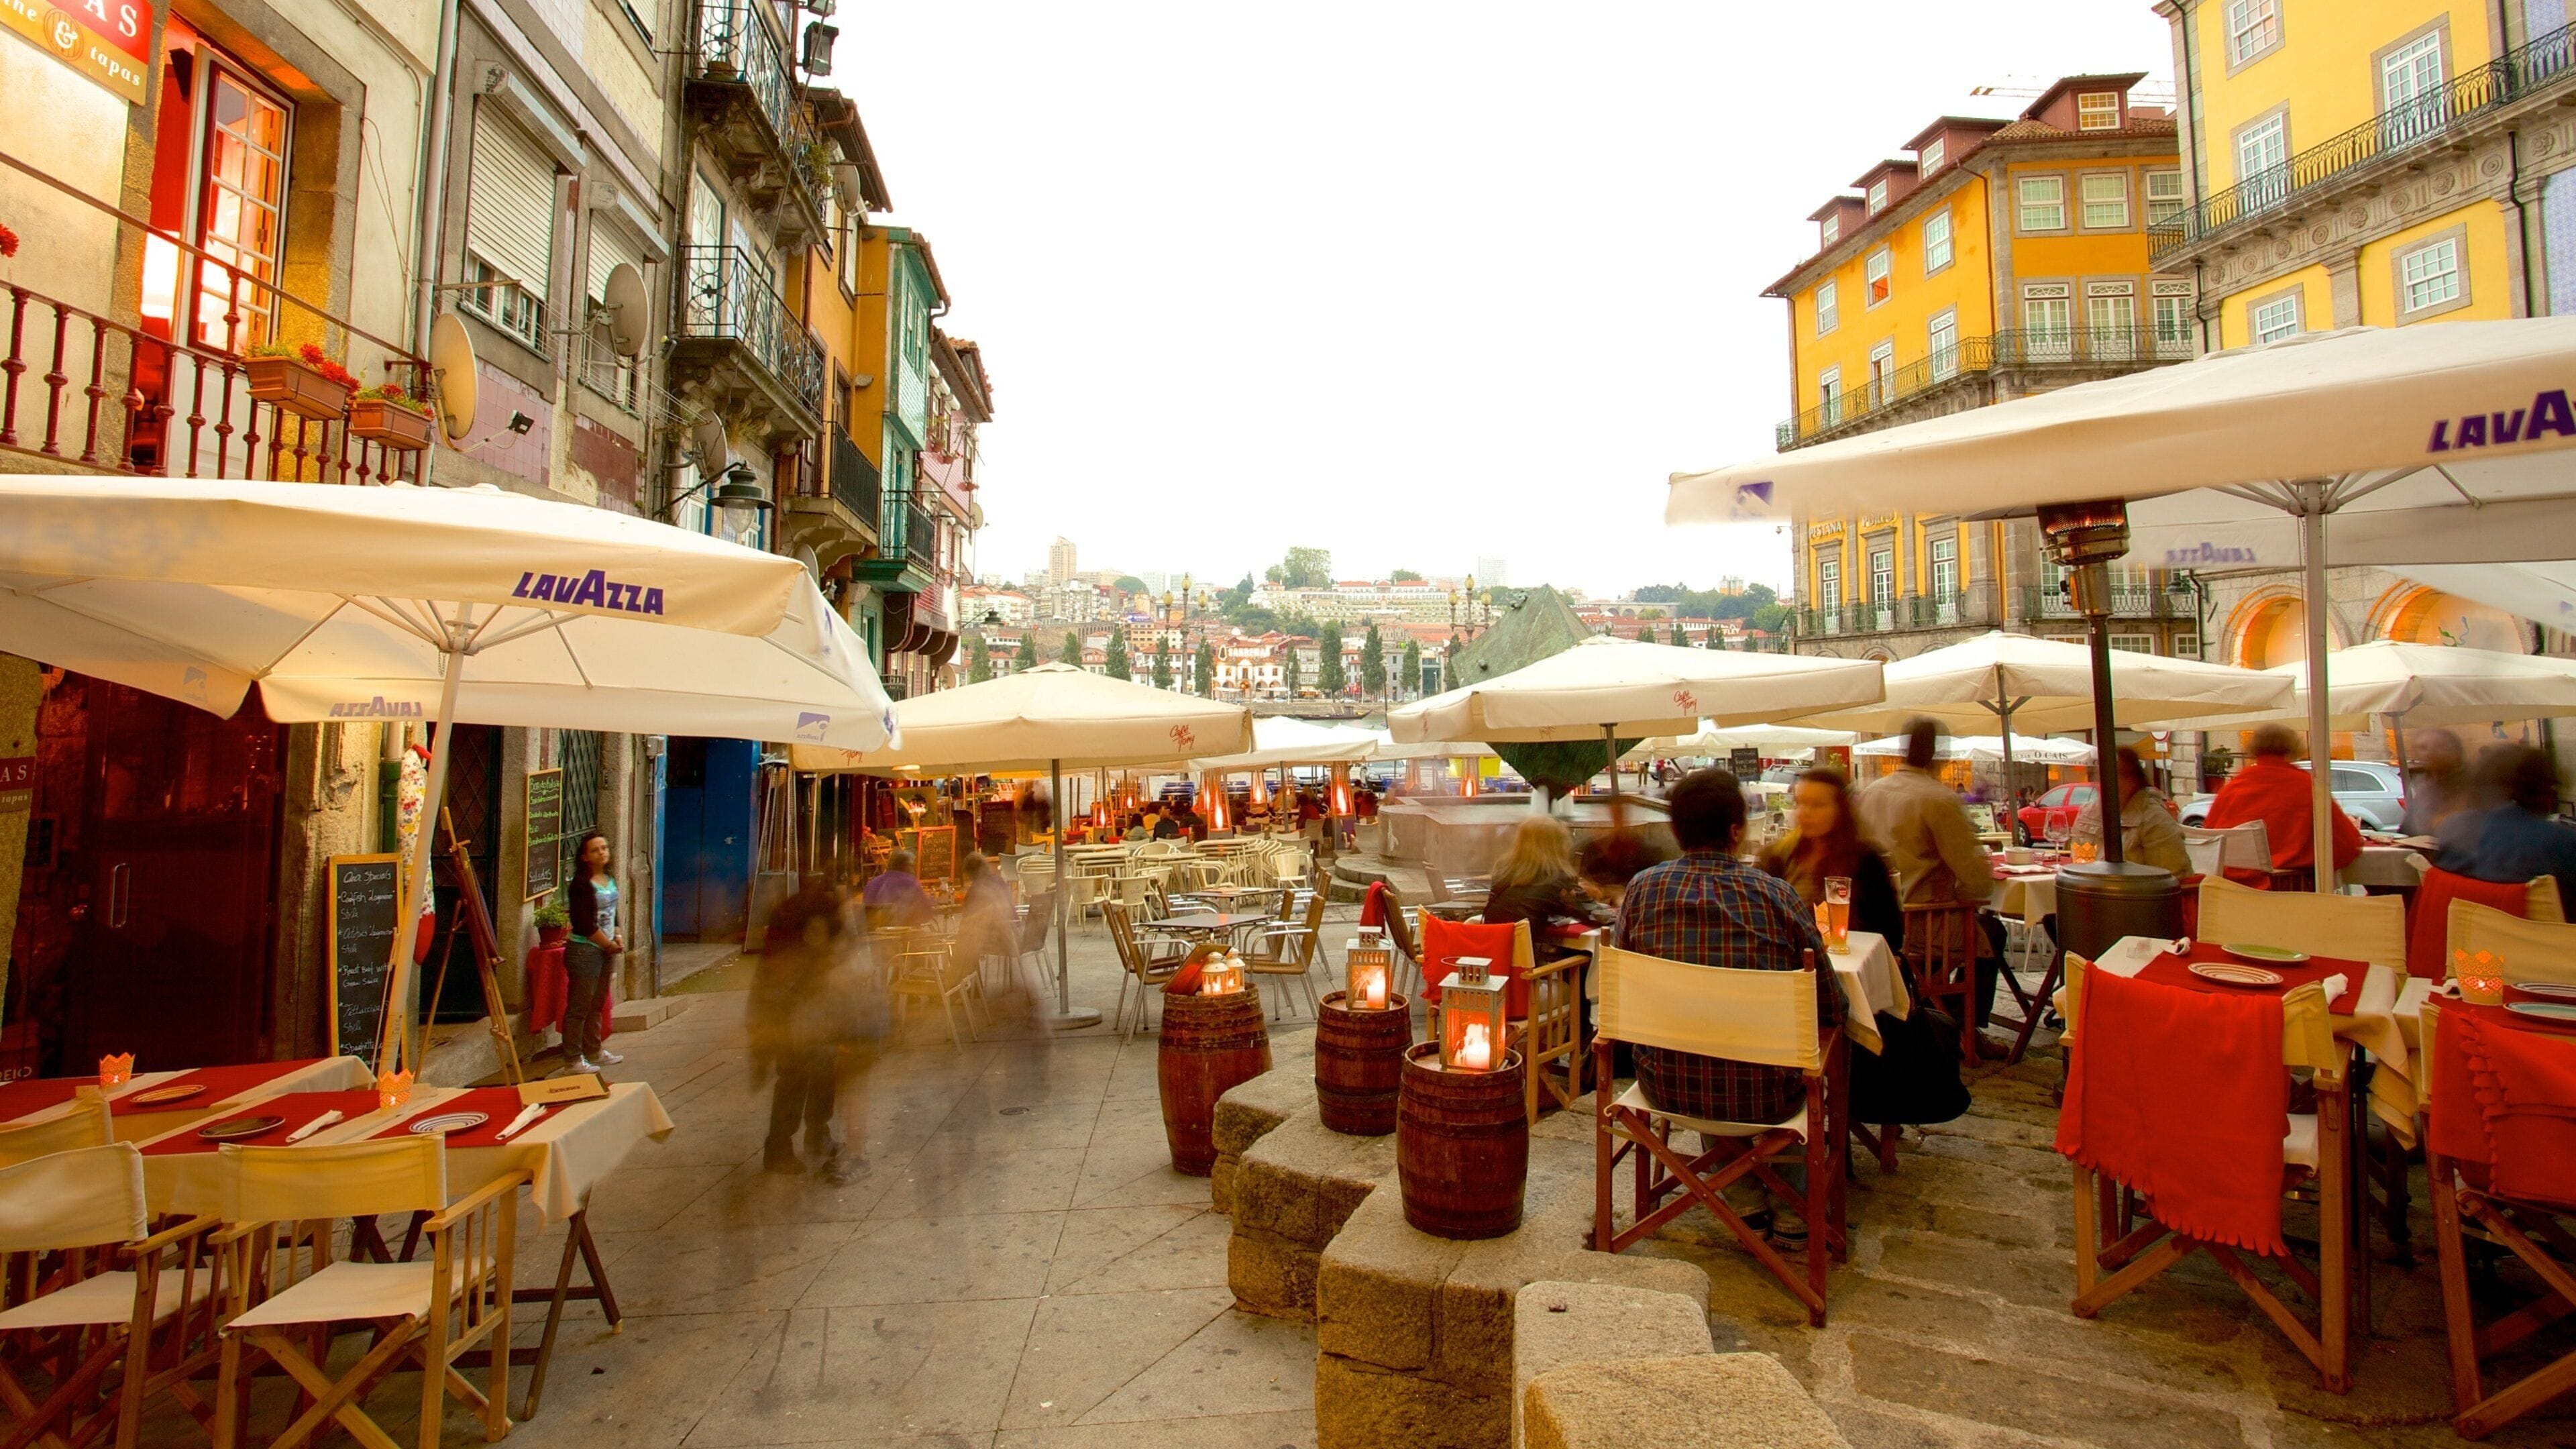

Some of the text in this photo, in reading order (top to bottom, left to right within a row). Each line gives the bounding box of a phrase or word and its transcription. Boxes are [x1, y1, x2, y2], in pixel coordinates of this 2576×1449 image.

[54, 21, 78, 49] &
[90, 46, 140, 86] tapas
[2426, 388, 2576, 453] LAVA
[511, 569, 664, 615] LAVAZZA
[2034, 751, 2069, 761] O CAIS
